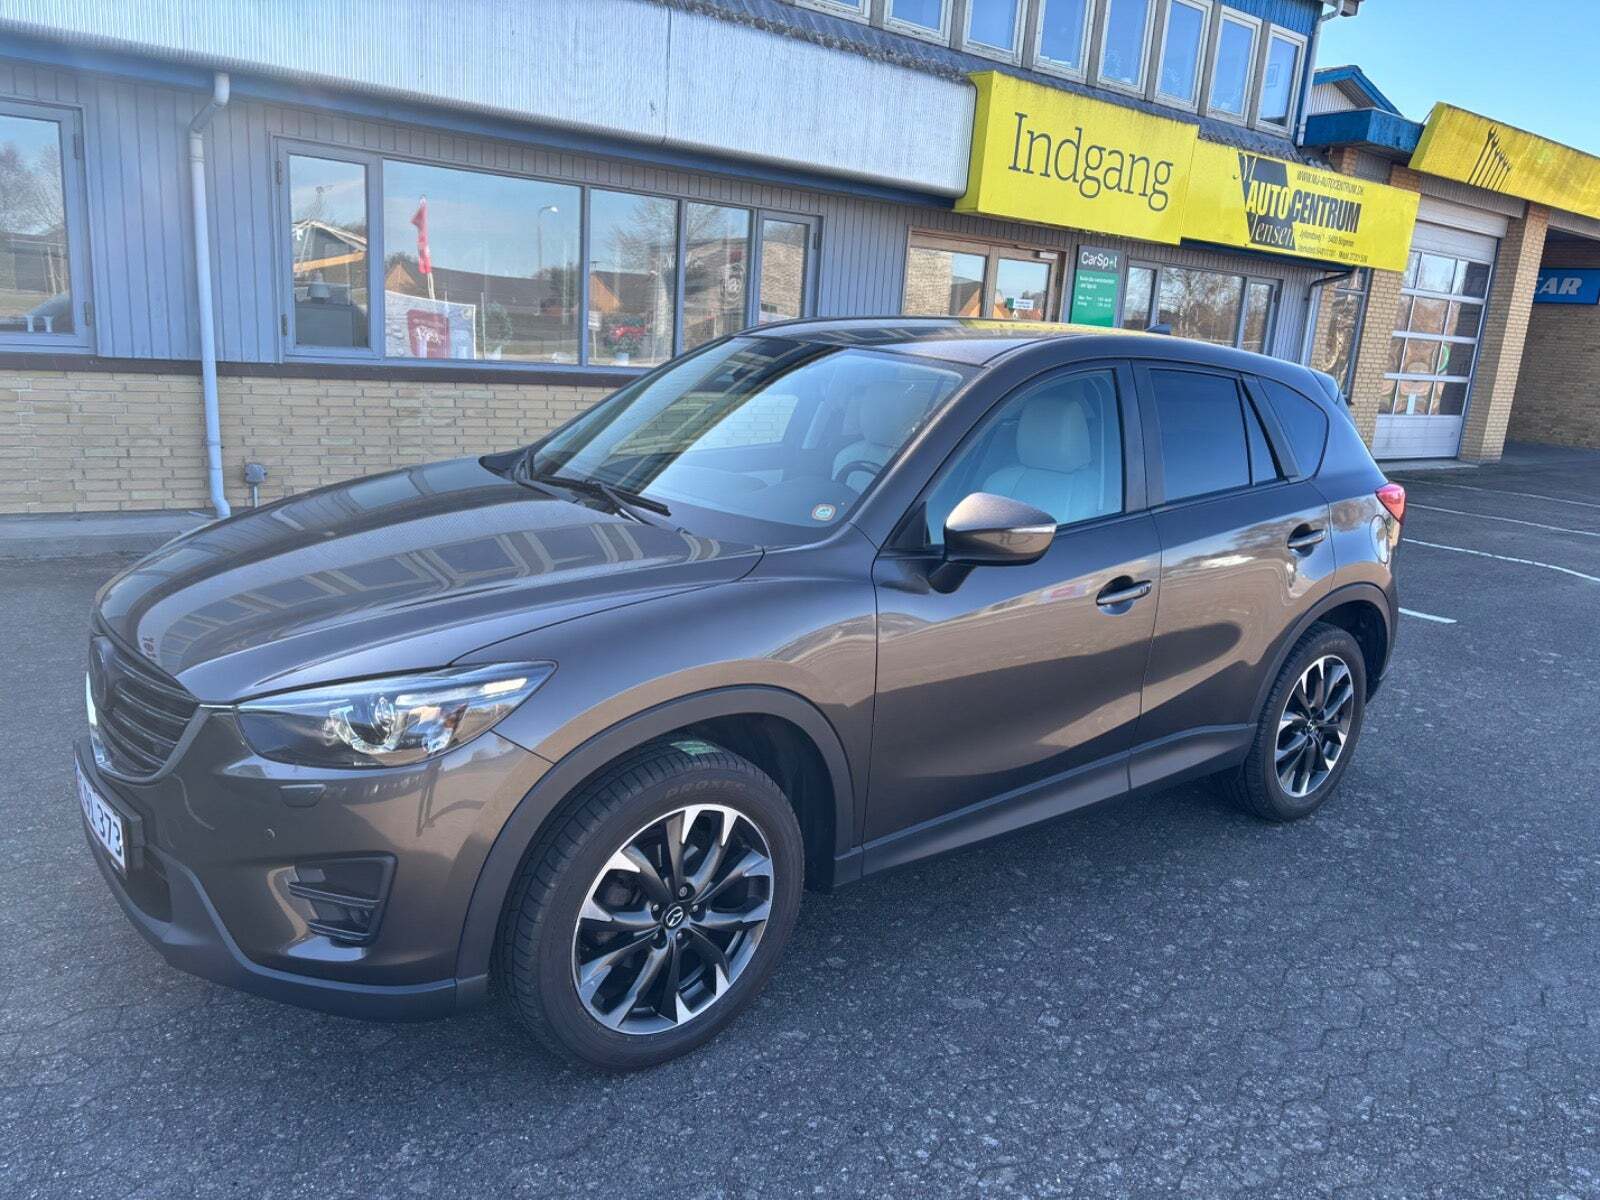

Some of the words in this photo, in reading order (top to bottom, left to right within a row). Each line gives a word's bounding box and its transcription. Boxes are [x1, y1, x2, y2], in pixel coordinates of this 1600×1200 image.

[1007, 111, 1174, 212] Indgang
[1246, 180, 1290, 220] AUTO
[1290, 189, 1362, 234] CENTRUM
[1249, 213, 1296, 247] Jensen
[1535, 277, 1582, 295] AR
[97, 803, 122, 857] 373
